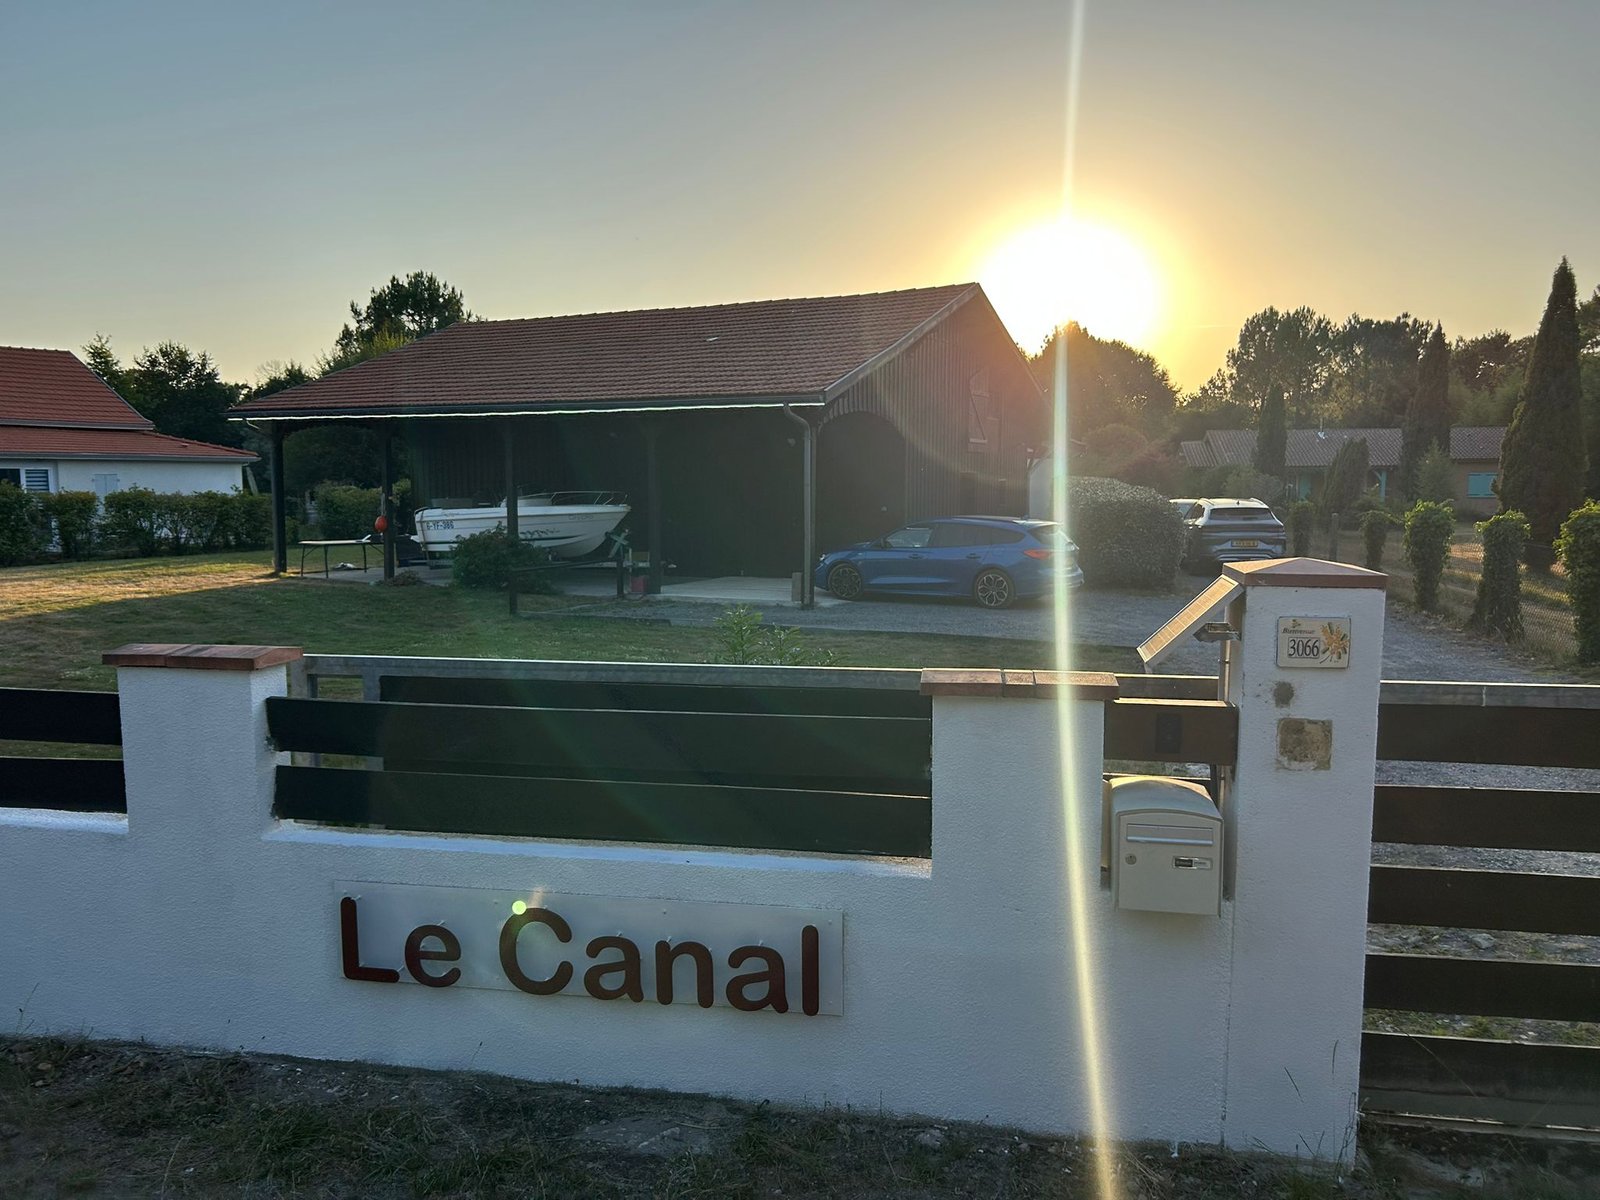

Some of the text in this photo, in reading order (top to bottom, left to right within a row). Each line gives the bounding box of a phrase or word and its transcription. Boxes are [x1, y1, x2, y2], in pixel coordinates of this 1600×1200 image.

[1288, 639, 1320, 657] 3066
[340, 896, 820, 1017] Le Canal
